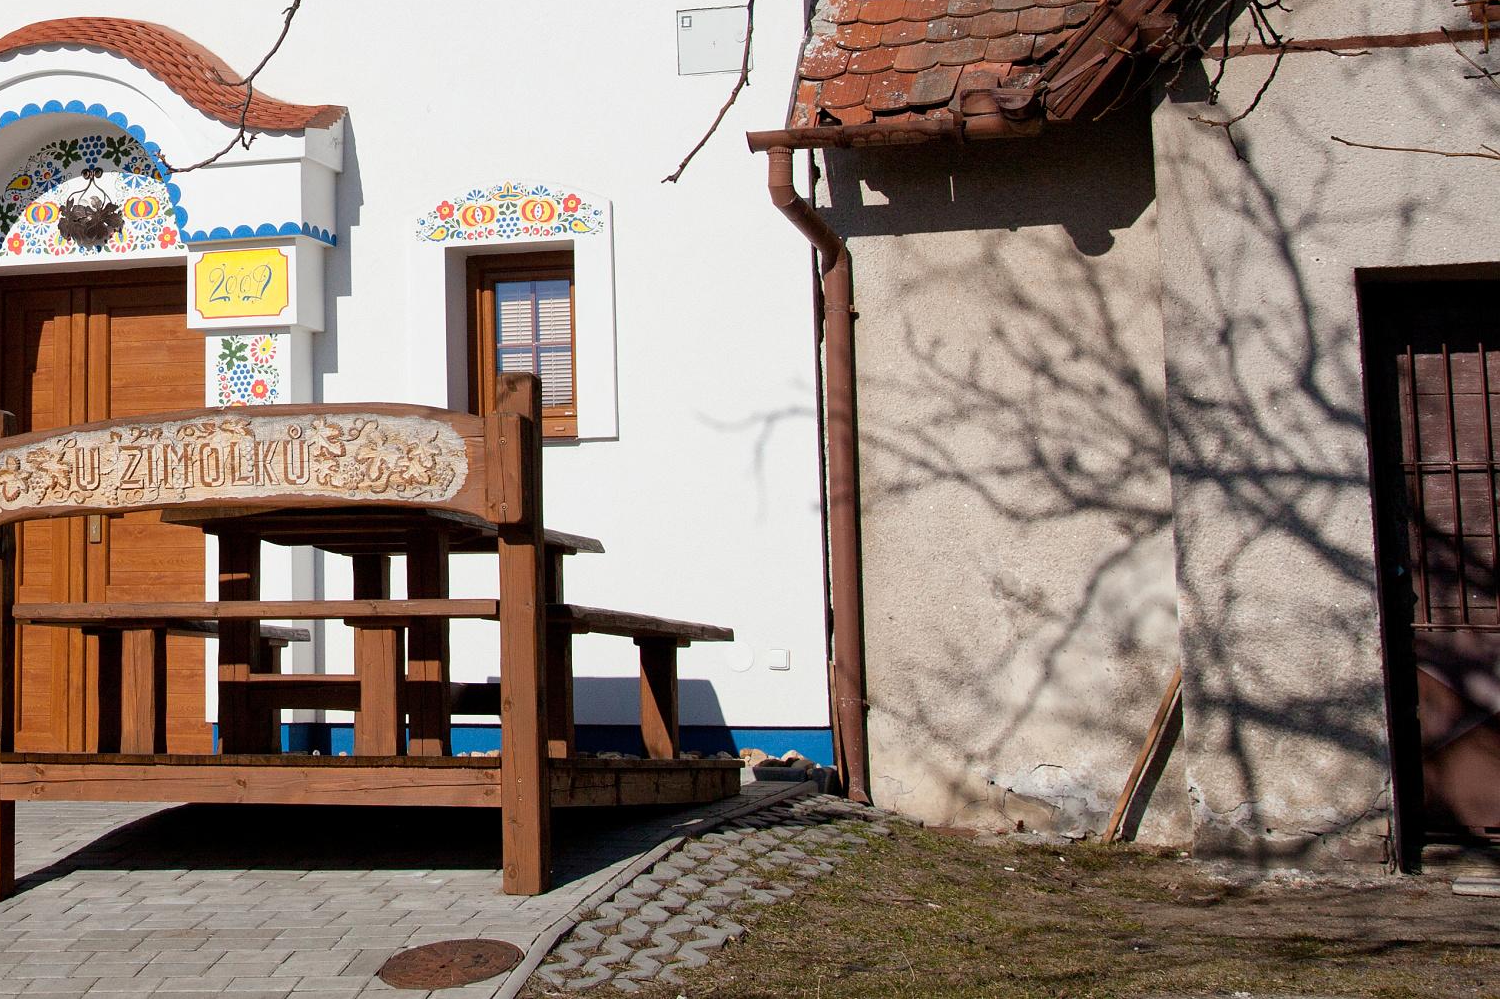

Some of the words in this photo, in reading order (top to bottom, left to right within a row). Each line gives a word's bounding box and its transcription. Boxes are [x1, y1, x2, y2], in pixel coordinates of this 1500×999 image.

[209, 263, 272, 302] 2009
[75, 446, 100, 491] U
[118, 423, 311, 490] ZIMOLKŮ
